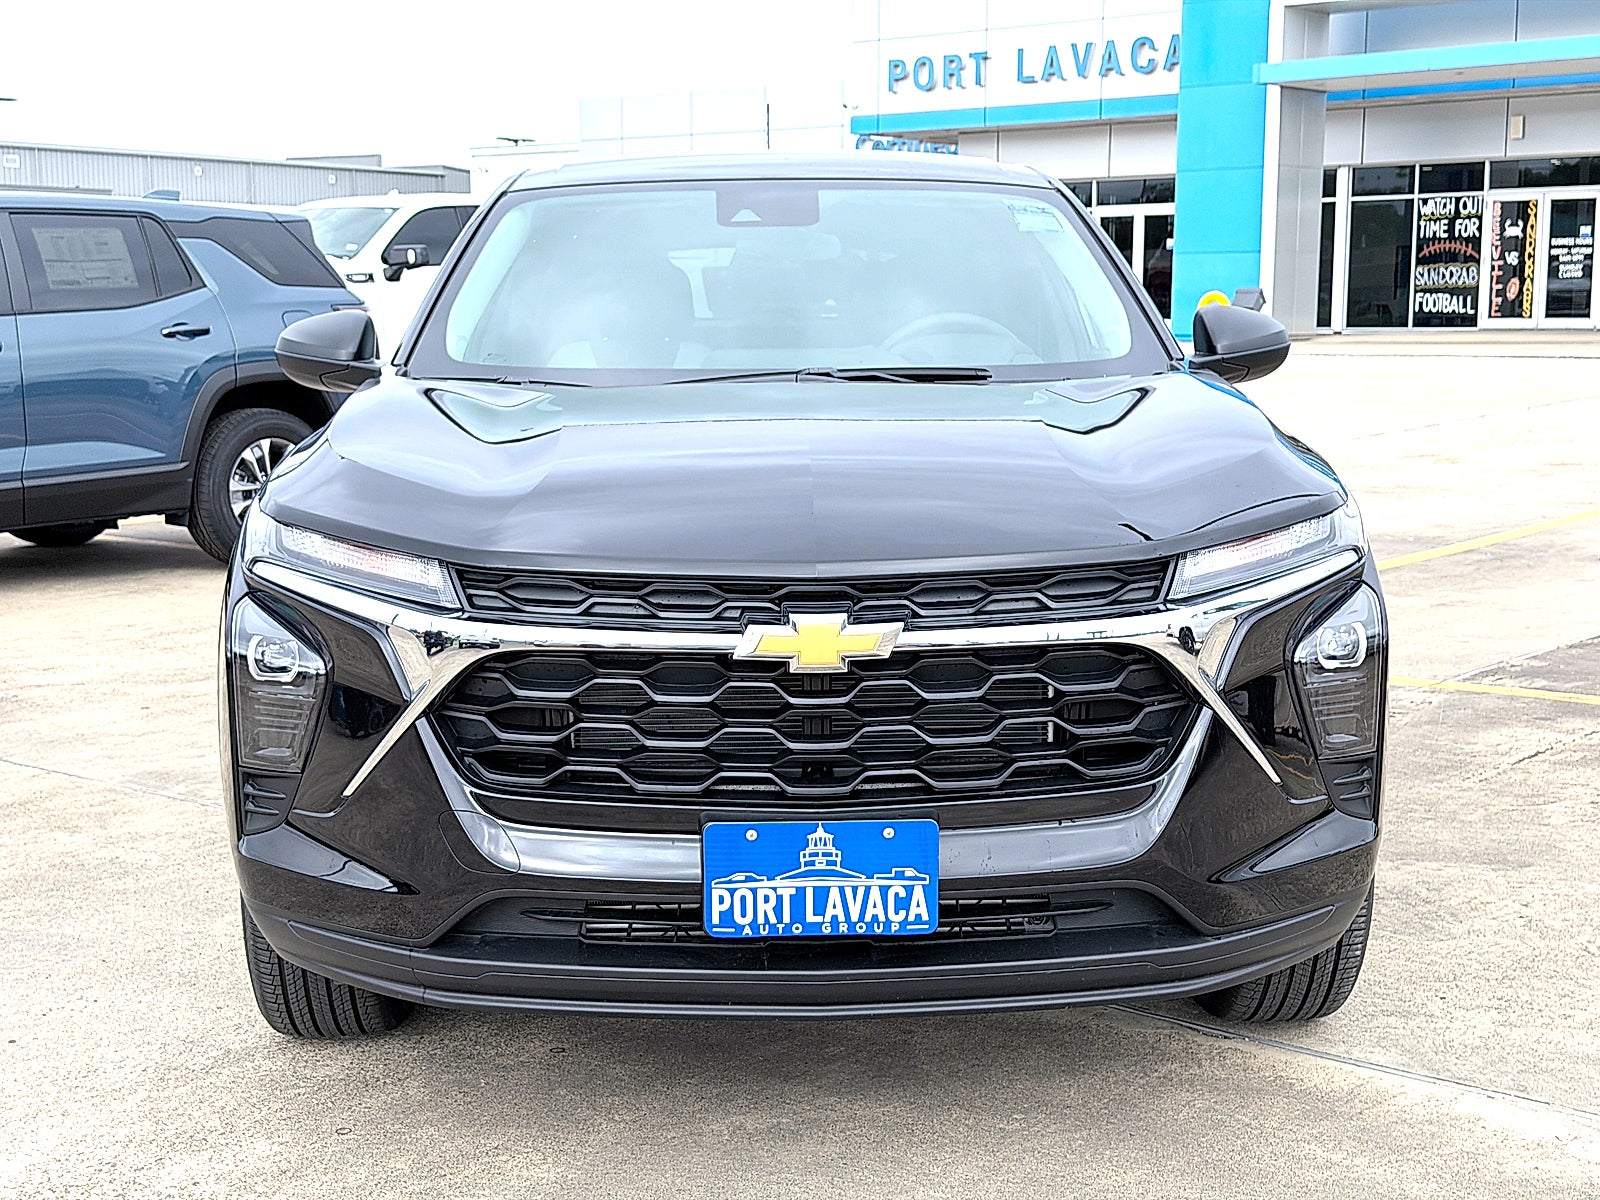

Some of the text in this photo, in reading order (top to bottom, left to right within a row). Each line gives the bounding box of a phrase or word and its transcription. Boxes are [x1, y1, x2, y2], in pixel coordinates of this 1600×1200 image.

[888, 34, 1180, 93] PORT LAVACA
[1419, 196, 1482, 216] WATCH OUT
[1419, 218, 1480, 239] TIME FOR
[1505, 250, 1520, 266] VS
[1522, 200, 1537, 317] SANDCRABS
[1415, 265, 1478, 287] SANDCRAB
[1414, 292, 1476, 315] FOOTBALL
[712, 885, 929, 925] PORT LAVACA
[742, 922, 901, 936] AUTO GROUP
